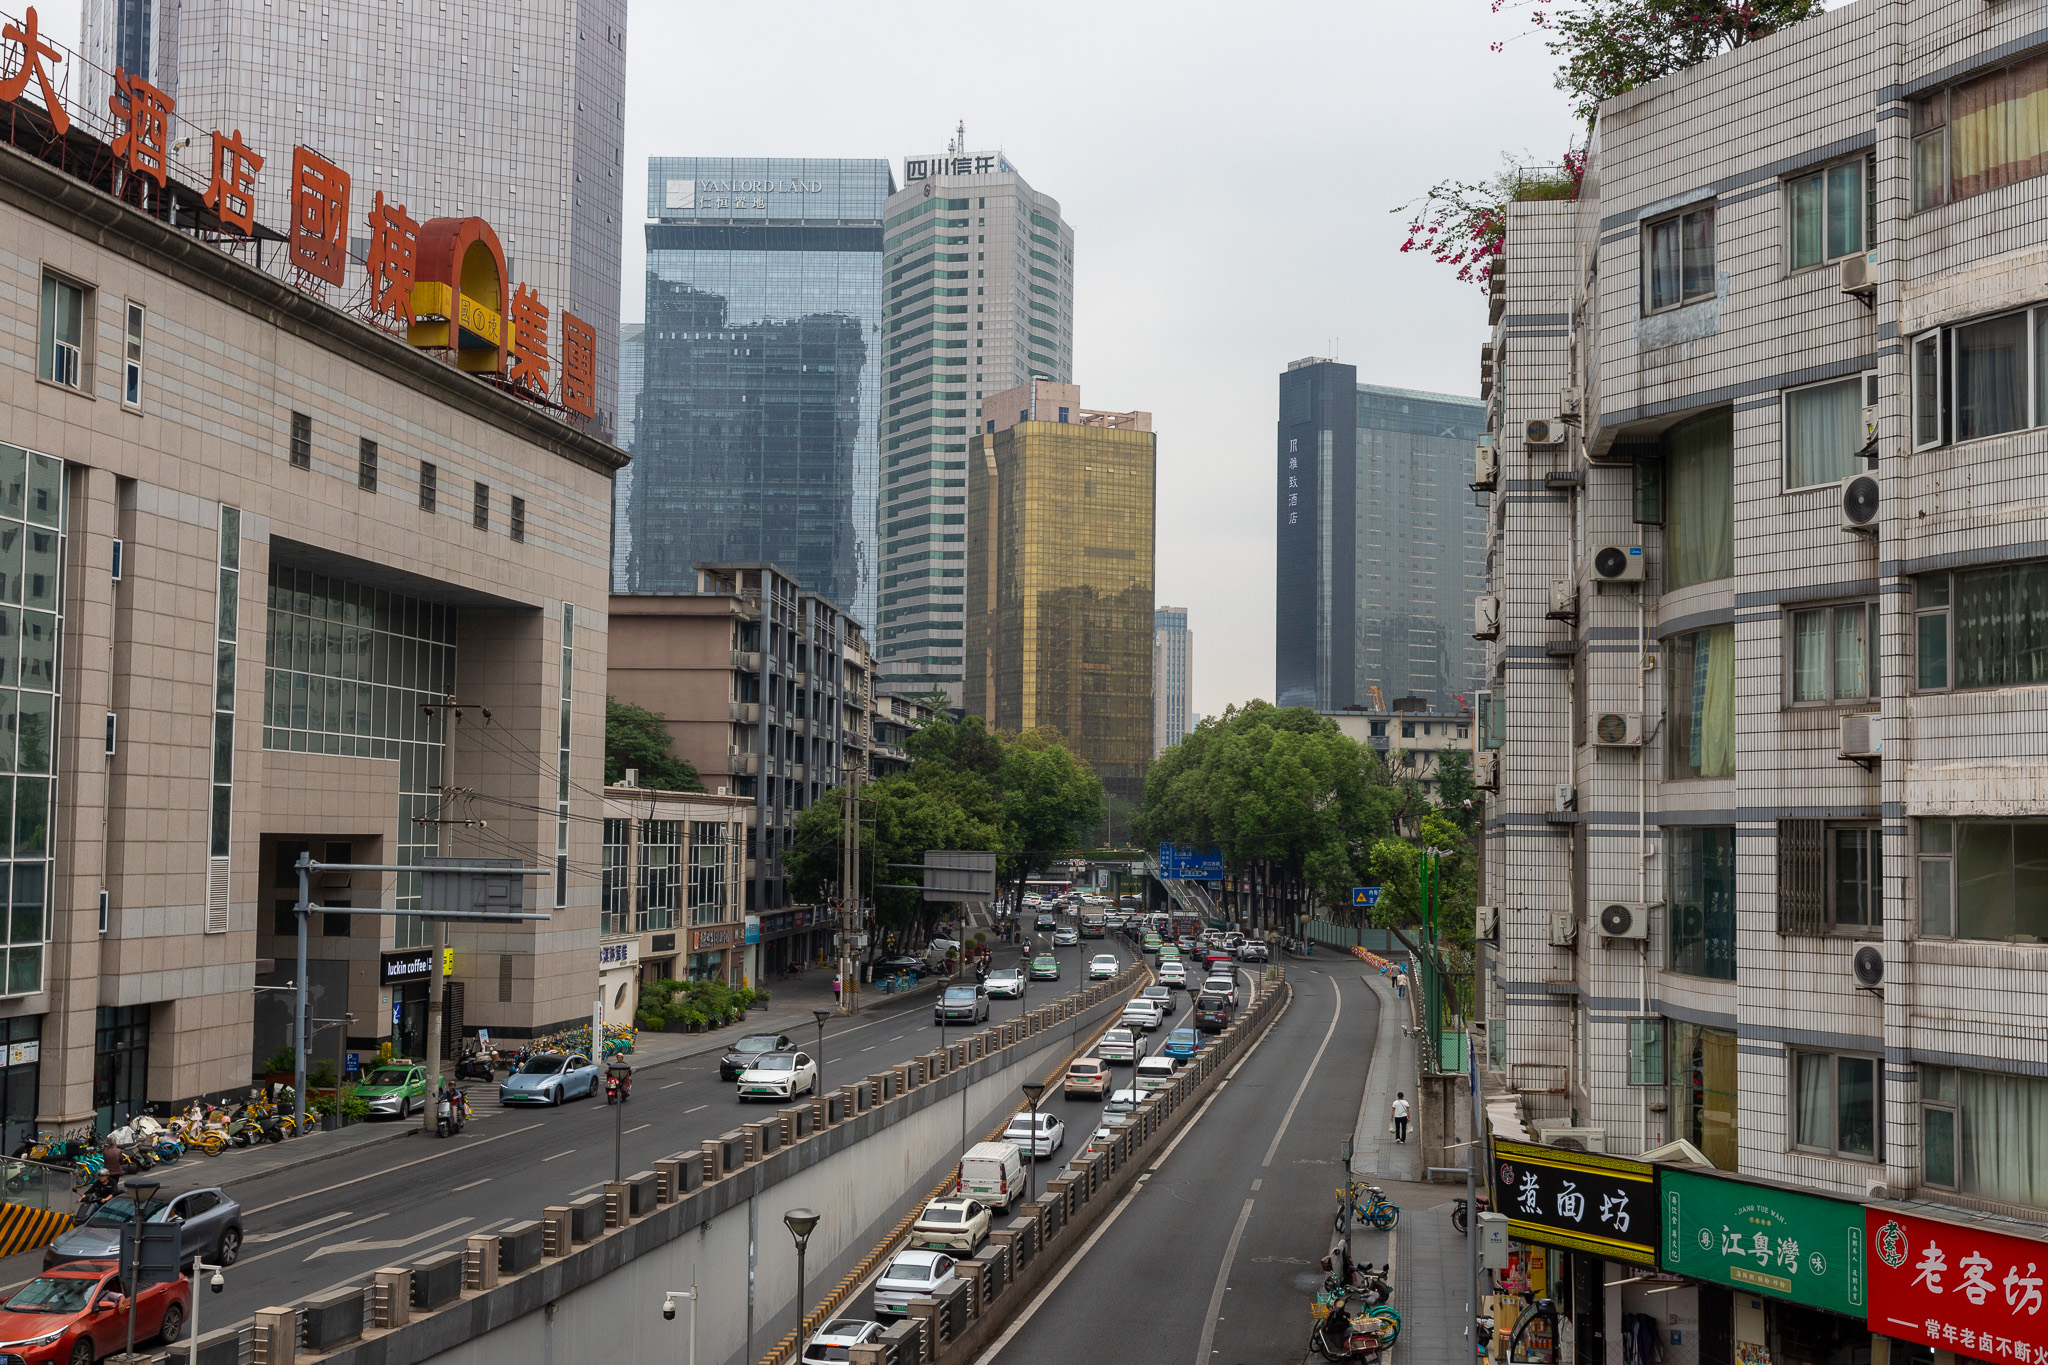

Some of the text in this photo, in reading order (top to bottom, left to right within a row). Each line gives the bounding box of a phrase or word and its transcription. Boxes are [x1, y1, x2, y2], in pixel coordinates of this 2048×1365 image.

[907, 155, 995, 181] 四川信托
[700, 179, 822, 193] YANLORD LAND
[699, 196, 765, 209] 仁恒置地
[387, 960, 407, 976] luckin
[407, 958, 426, 974] coffee
[347, 1053, 353, 1062] P
[1516, 1170, 1631, 1233] 煮面坊
[1738, 1204, 1755, 1215] JIANG
[1756, 1204, 1769, 1214] YUE
[1770, 1209, 1785, 1224] WAN
[1910, 1239, 2045, 1317] 老客坊
